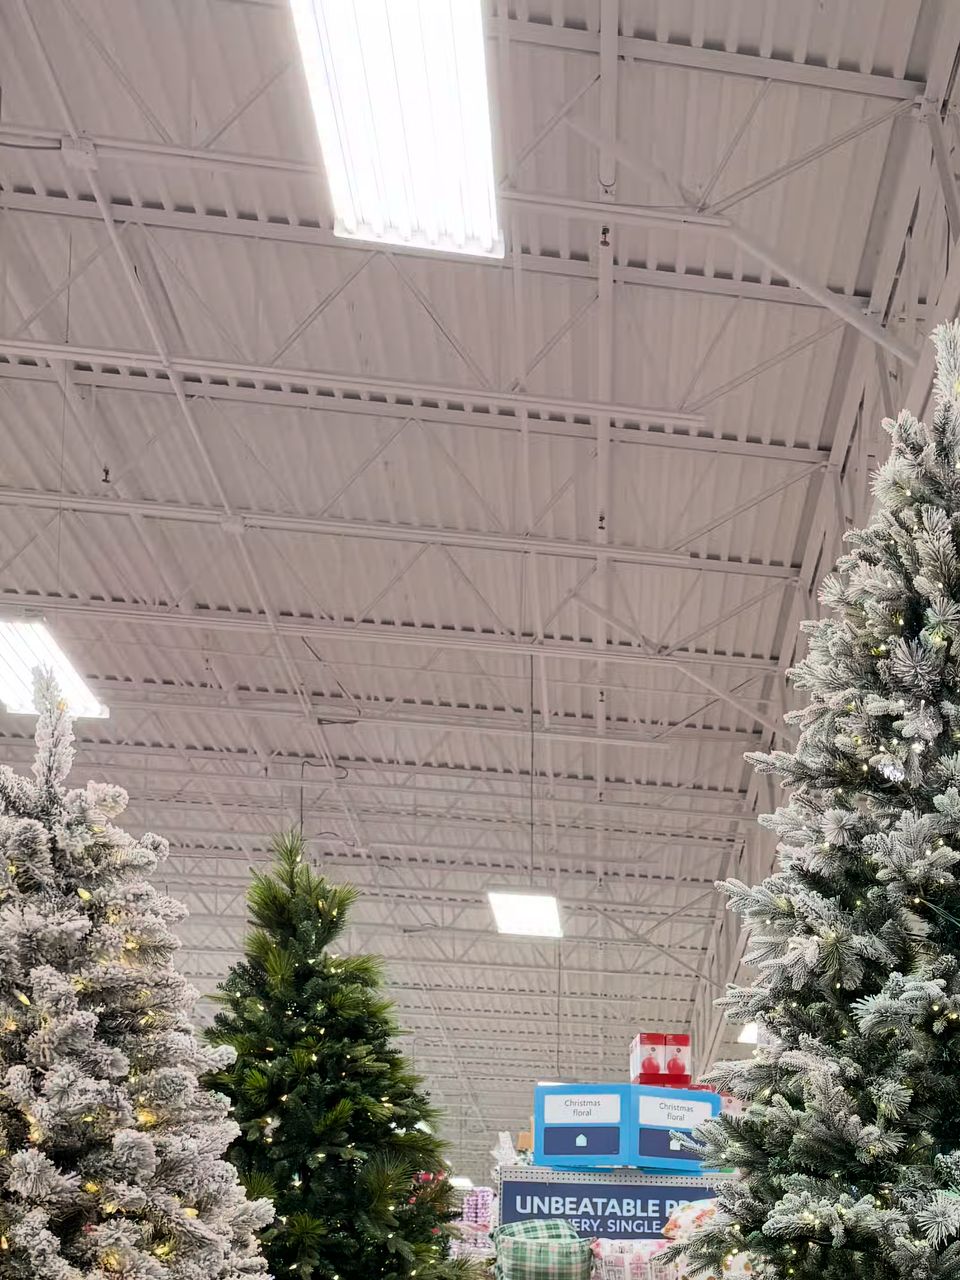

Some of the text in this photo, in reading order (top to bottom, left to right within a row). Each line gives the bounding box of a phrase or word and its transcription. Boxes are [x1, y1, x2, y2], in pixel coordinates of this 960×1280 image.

[564, 1098, 601, 1108] Christmas
[659, 1102, 694, 1113] Christmas
[572, 1108, 592, 1117] floral
[666, 1113, 685, 1121] floral
[515, 1195, 660, 1217] UNBEATABLE
